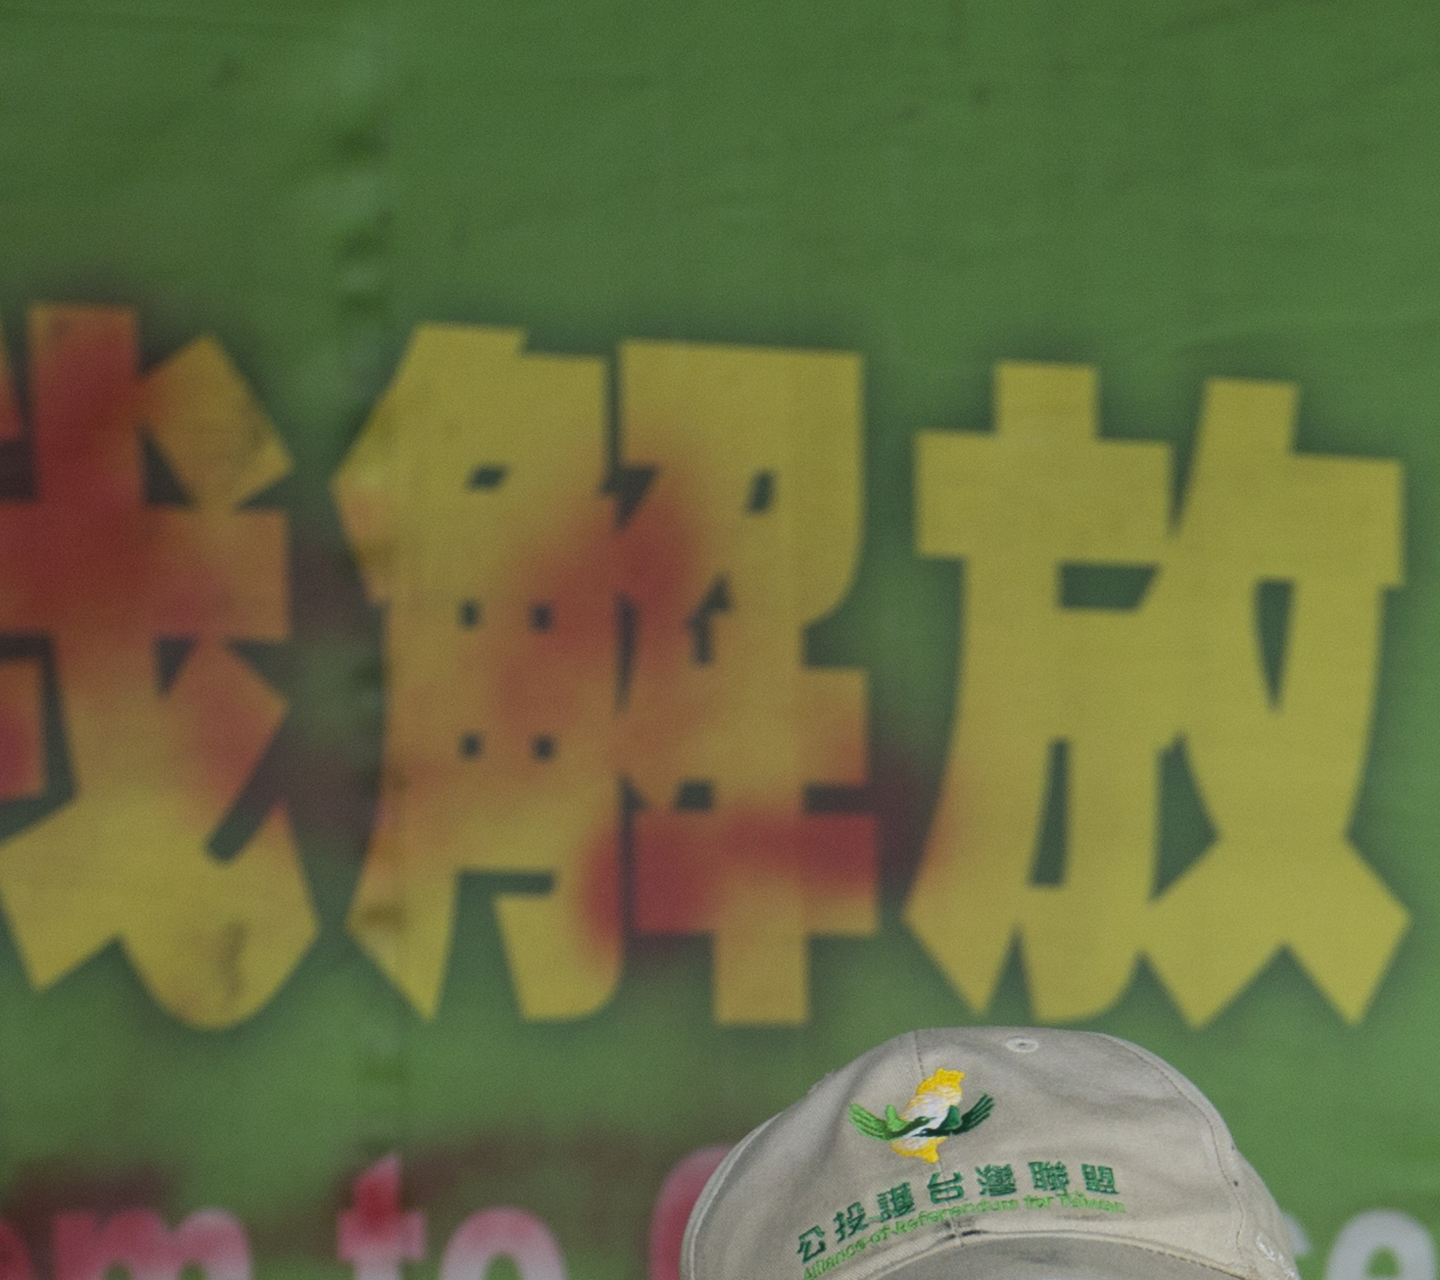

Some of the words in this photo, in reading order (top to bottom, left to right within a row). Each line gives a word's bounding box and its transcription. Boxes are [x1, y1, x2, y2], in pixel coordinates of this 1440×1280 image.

[797, 1160, 1120, 1265] 公投護台灣聯盟
